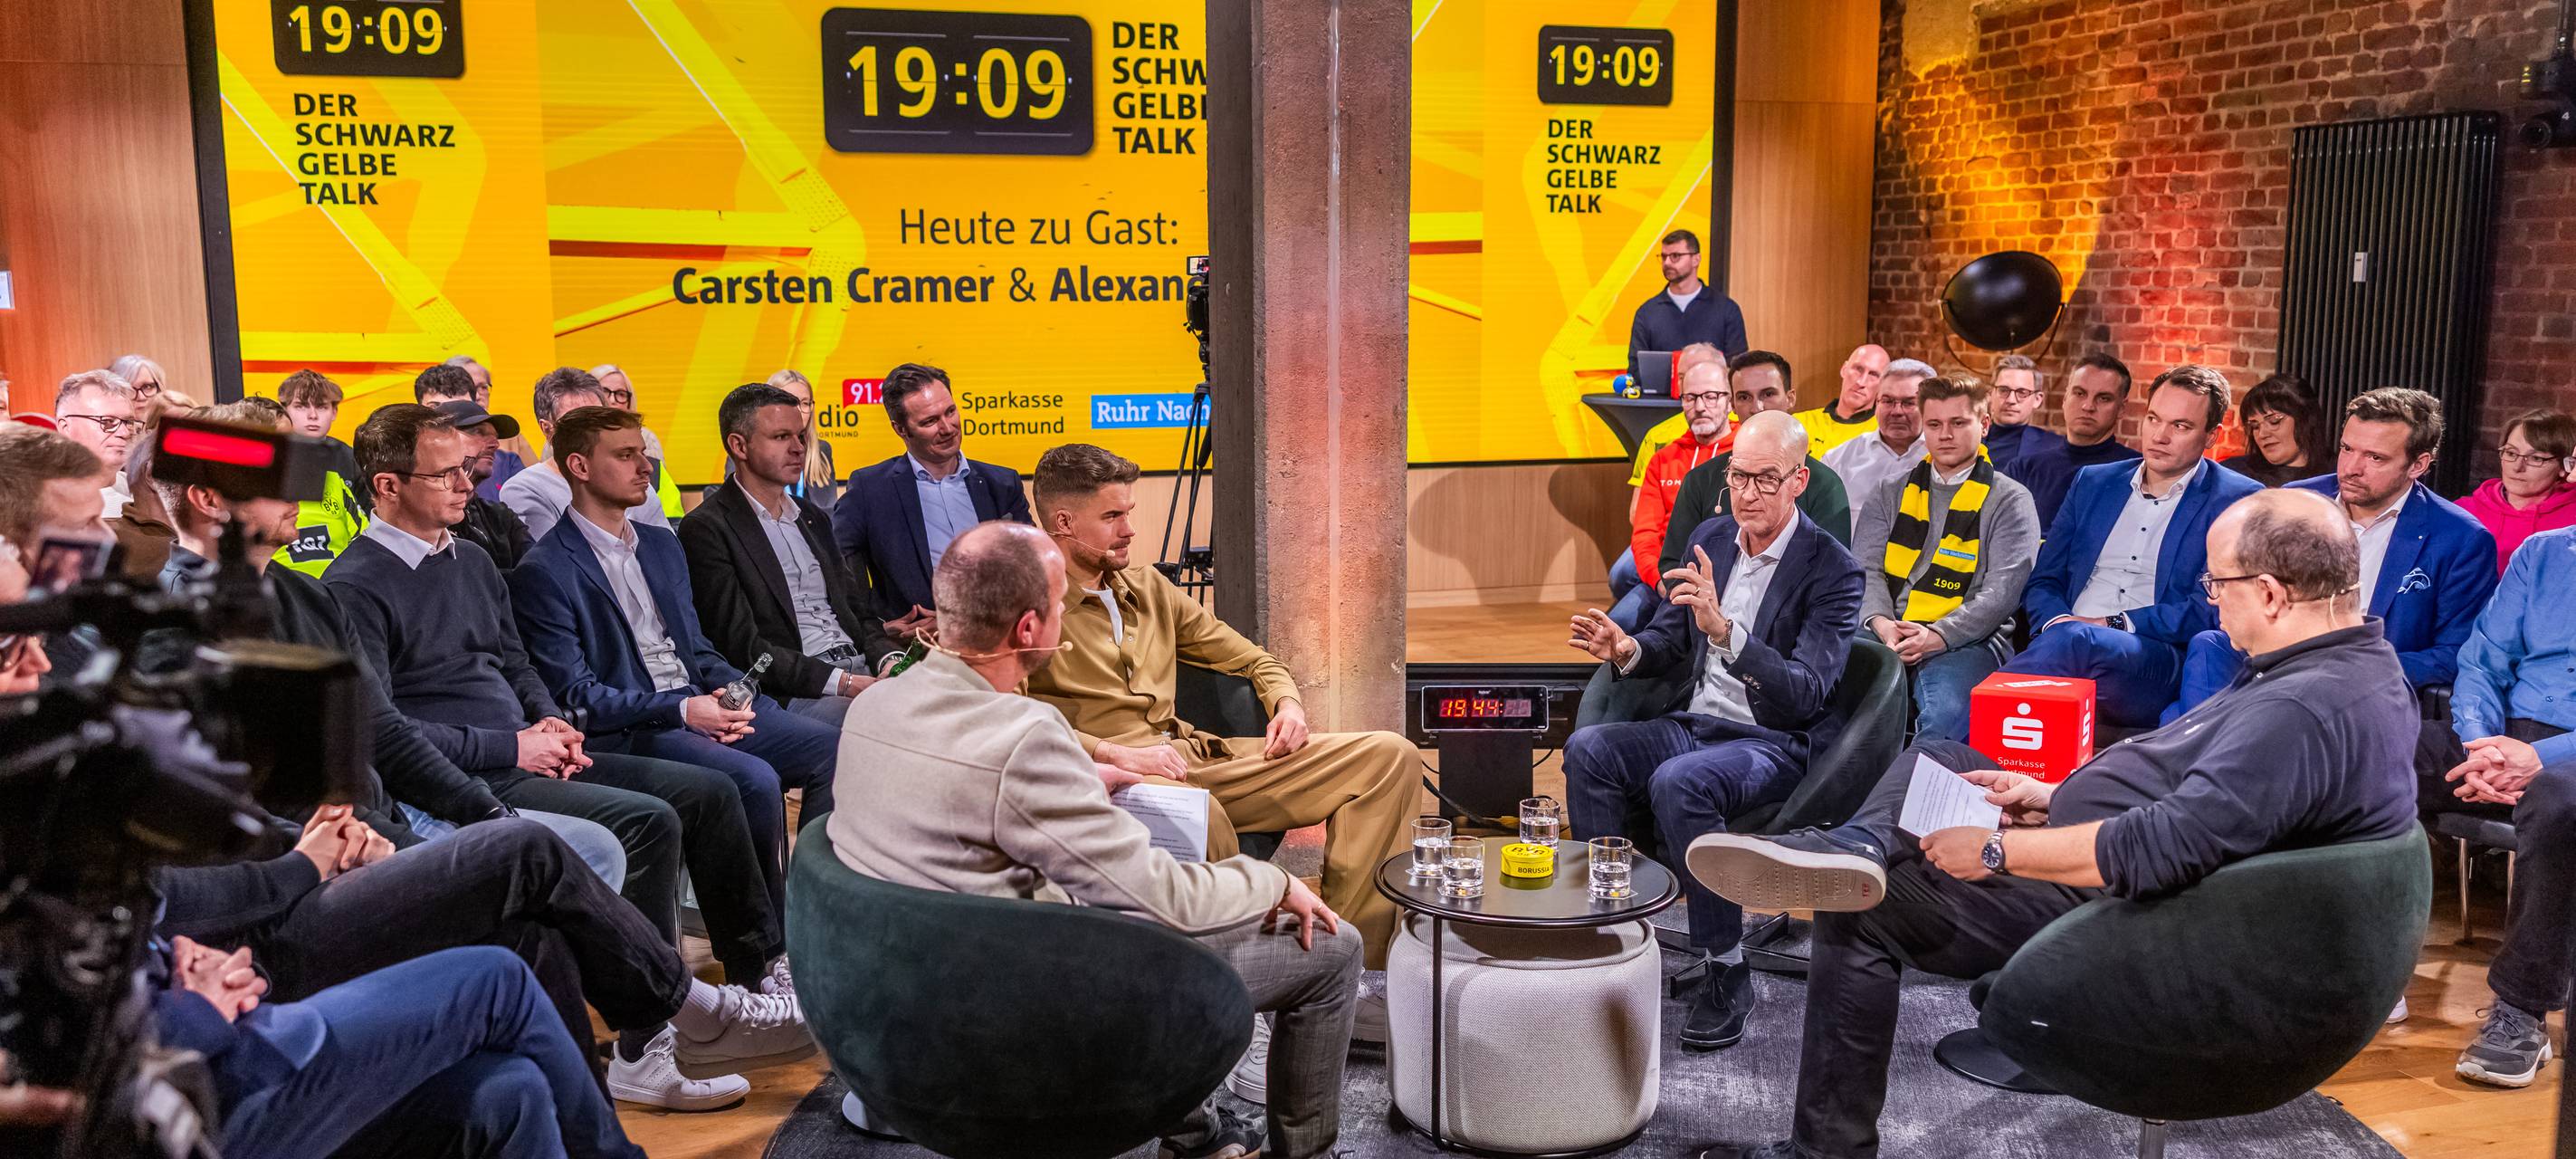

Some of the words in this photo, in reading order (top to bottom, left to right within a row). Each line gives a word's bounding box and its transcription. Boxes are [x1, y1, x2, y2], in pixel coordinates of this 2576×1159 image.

[289, 5, 444, 55] 19:09
[1112, 21, 1179, 50] DER
[1549, 43, 1661, 88] 19:09
[848, 45, 1067, 120] 19:09
[293, 92, 358, 118] DER
[295, 122, 455, 148] SCHWARZ
[1111, 127, 1197, 155] TALK
[1548, 119, 1593, 139] DER
[298, 152, 397, 177] GELBE
[1547, 144, 1661, 165] SCHWARZ
[1547, 168, 1617, 188] GELBE
[298, 182, 378, 206] TALK
[1546, 194, 1602, 214] TALK
[900, 208, 1016, 245] Heute
[1029, 218, 1072, 245] zu
[1085, 209, 1178, 245] Gast:
[673, 267, 833, 305] Carsten
[847, 265, 995, 303] Cramer
[1009, 266, 1037, 302] &
[961, 390, 1064, 414] Sparkasse
[1097, 398, 1151, 423] Ruhr
[818, 405, 859, 427] dio
[963, 416, 1064, 436] Dortmund
[817, 430, 859, 438] ORTMUND
[1933, 578, 1961, 590] 1909
[1998, 756, 2046, 769] Sparkasse
[1517, 867, 1550, 875] BORUSSIA
